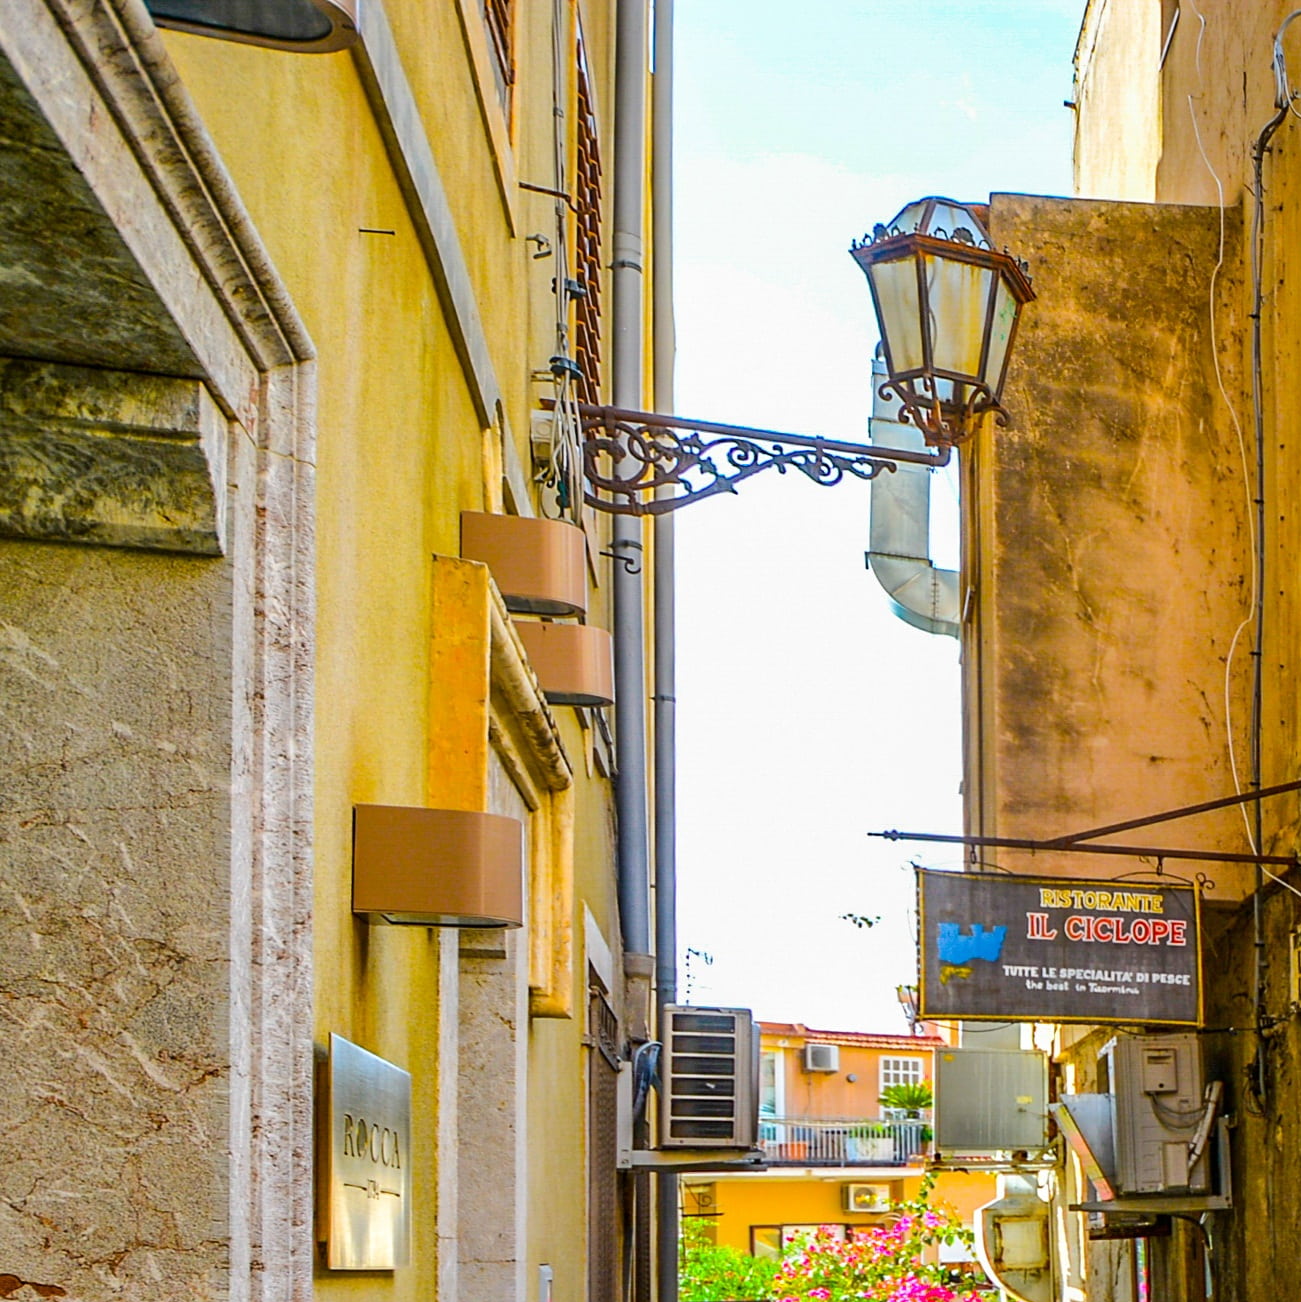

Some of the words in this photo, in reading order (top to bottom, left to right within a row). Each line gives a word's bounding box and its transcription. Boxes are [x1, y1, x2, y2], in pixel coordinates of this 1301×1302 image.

[1039, 887, 1164, 914] RISTORANTE
[1026, 912, 1057, 941] IL
[1065, 915, 1188, 946] CICLOPE
[1002, 964, 1039, 978] TUTTE
[1042, 967, 1057, 979] LE
[1136, 972, 1150, 983] DI
[1152, 973, 1191, 986] PESCE
[1046, 979, 1070, 991] best
[343, 1113, 401, 1169] ROCCA
